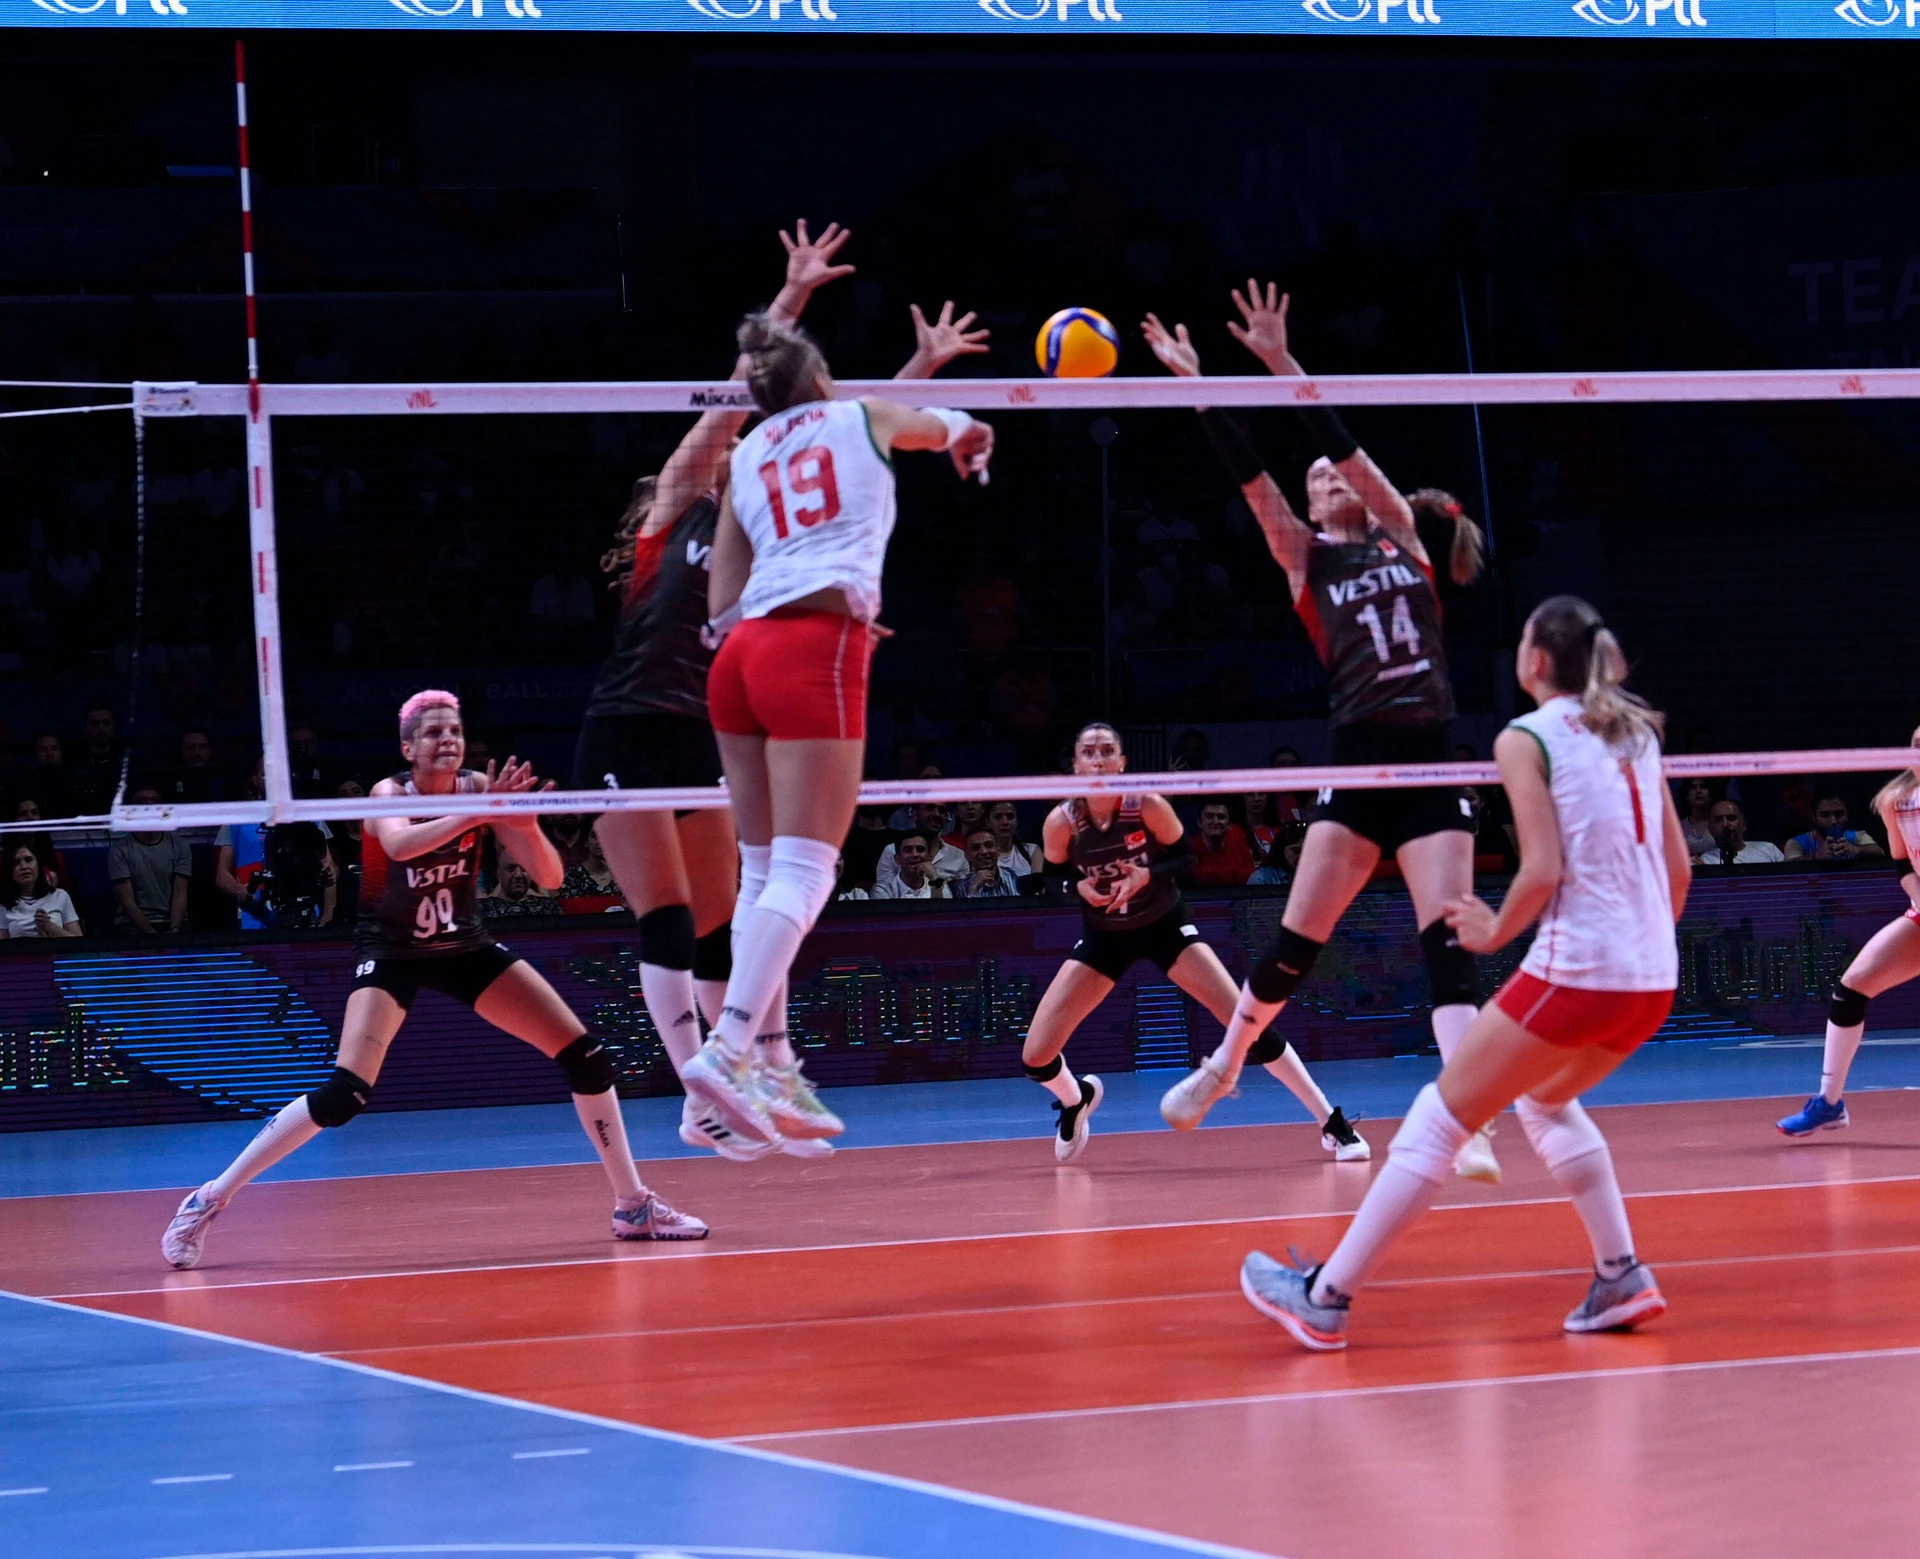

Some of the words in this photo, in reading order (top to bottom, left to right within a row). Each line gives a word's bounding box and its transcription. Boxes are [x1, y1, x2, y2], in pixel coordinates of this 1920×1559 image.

[759, 446, 842, 540] 19
[1355, 594, 1421, 663] 14
[1618, 758, 1646, 844] 1
[413, 888, 459, 939] 99
[355, 960, 376, 978] 99
